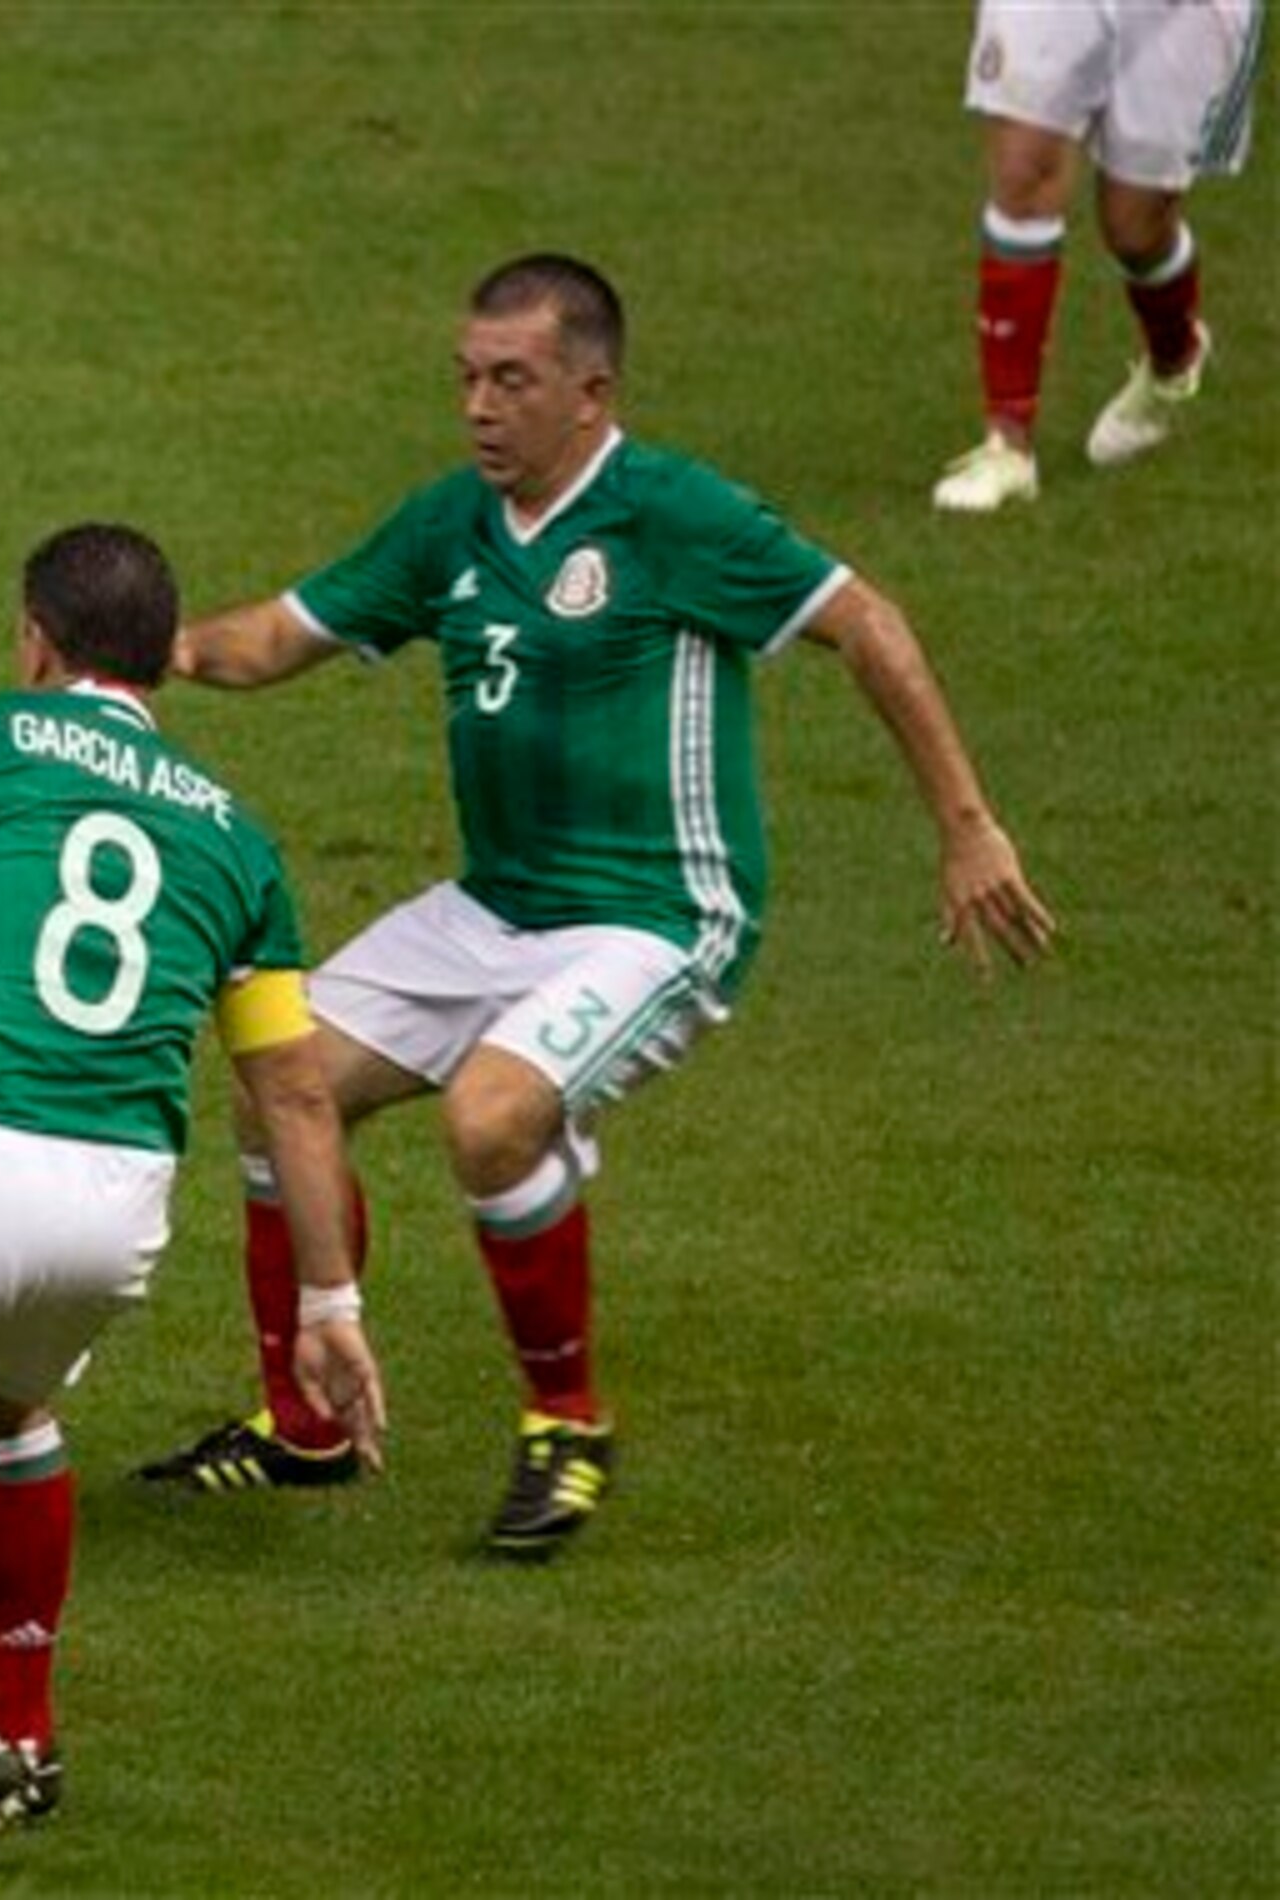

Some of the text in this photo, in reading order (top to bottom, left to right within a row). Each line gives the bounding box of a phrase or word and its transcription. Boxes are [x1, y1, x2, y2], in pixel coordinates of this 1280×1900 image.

[476, 622, 520, 713] 3
[11, 711, 233, 832] GARCIA ASPE
[34, 810, 162, 1036] 8
[537, 985, 612, 1059] 3
